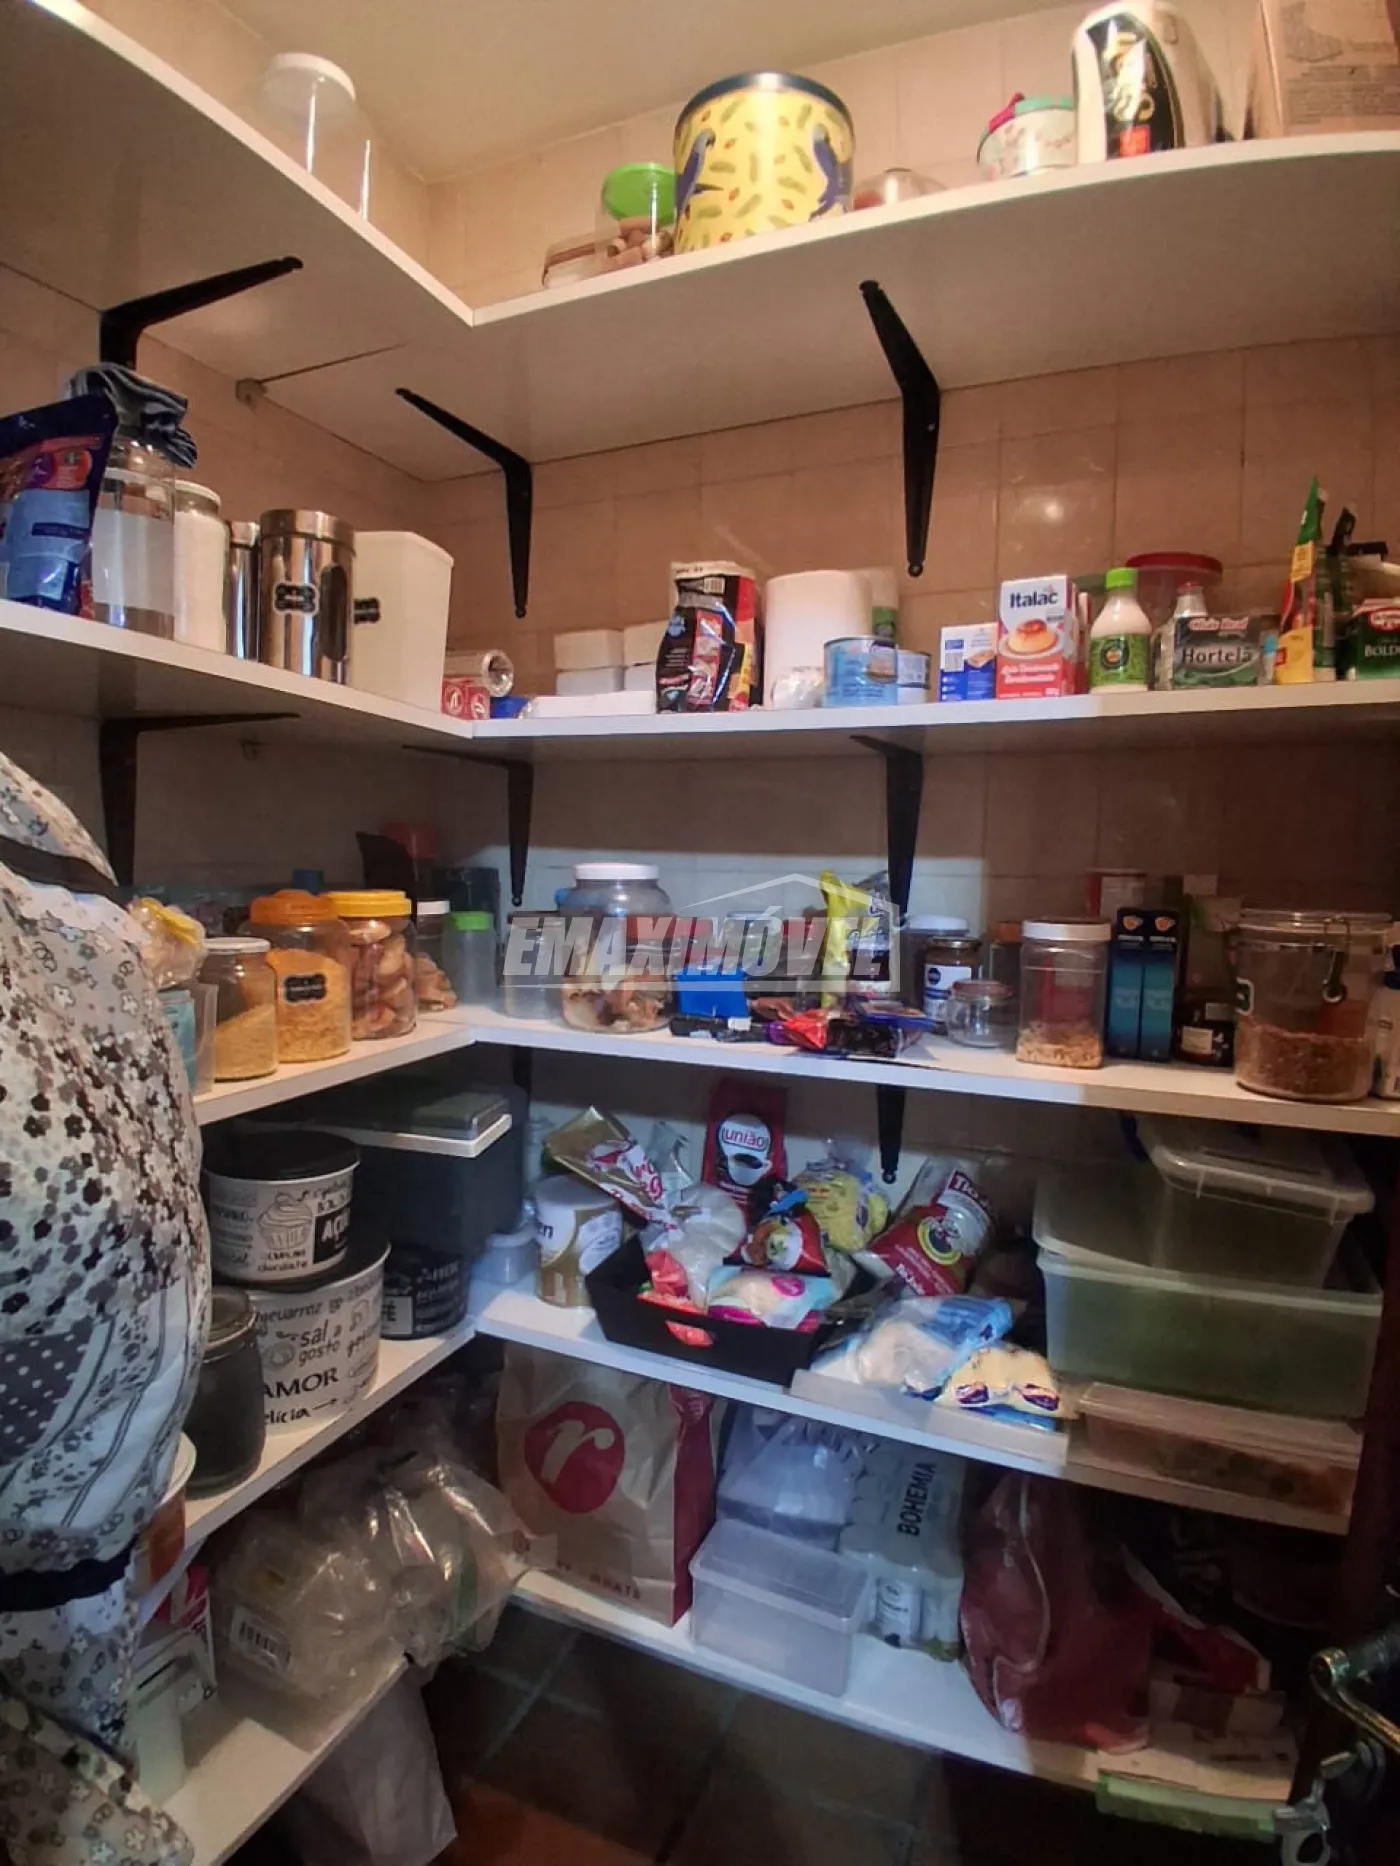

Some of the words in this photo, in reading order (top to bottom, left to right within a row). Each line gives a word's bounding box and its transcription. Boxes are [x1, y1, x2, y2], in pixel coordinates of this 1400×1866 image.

[1009, 590, 1059, 609] Italac
[724, 1126, 764, 1149] união
[299, 1318, 329, 1348] sal
[896, 1462, 937, 1537] BOHEMIA
